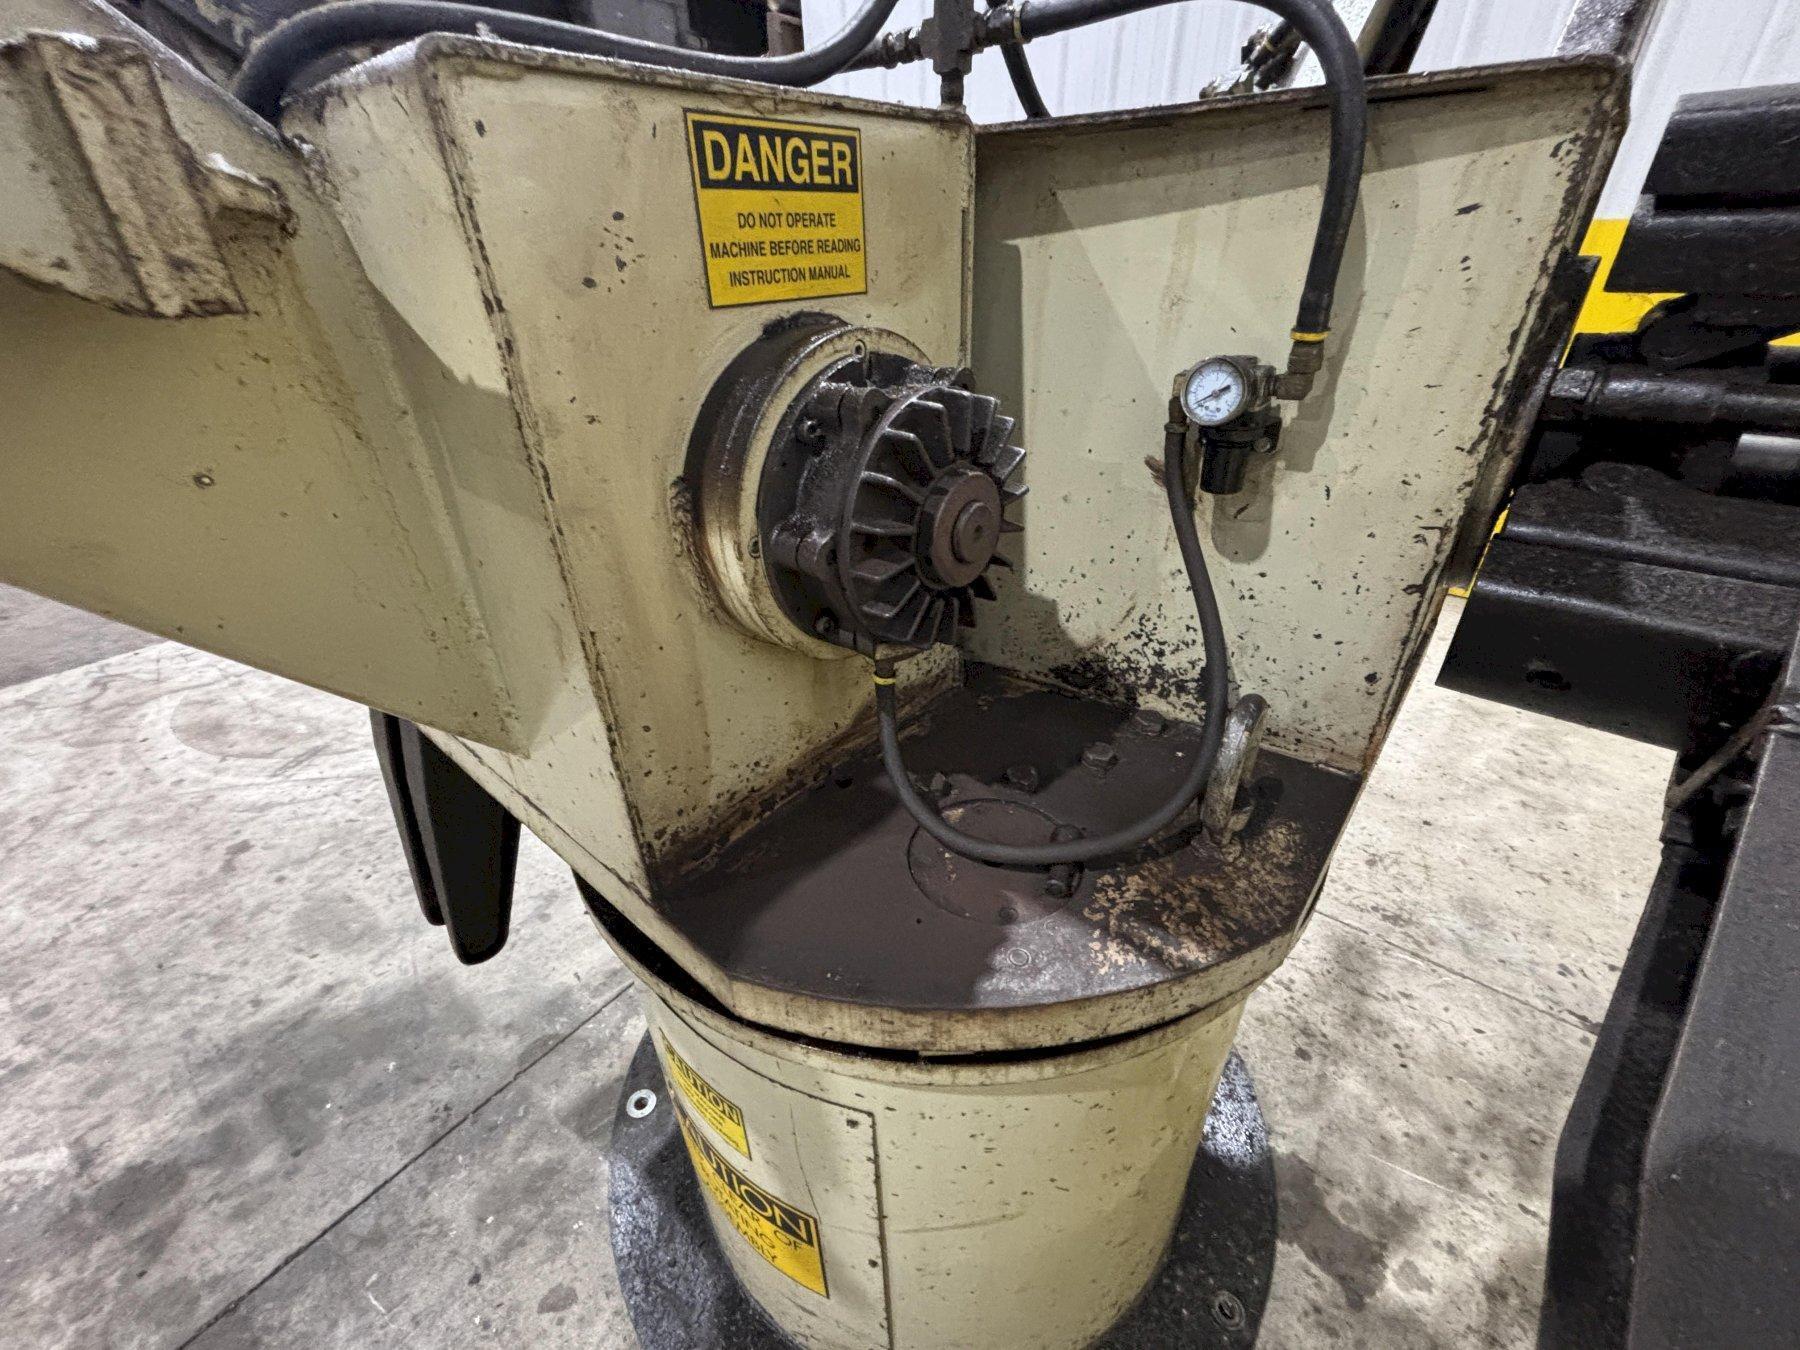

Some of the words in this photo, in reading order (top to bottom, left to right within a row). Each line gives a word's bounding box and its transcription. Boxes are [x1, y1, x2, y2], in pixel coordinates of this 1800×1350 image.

[702, 129, 853, 185] DANGER
[737, 213, 756, 229] DO
[759, 212, 784, 228] NOT
[786, 212, 836, 228] OPERATE
[709, 241, 767, 259] MACHINE
[770, 239, 814, 256] BEFORE
[817, 238, 861, 254] READING
[729, 267, 806, 287] INSTRUCTION
[809, 265, 851, 281] MANUAL
[688, 1122, 808, 1243] UTION
[773, 1228, 802, 1251] OF
